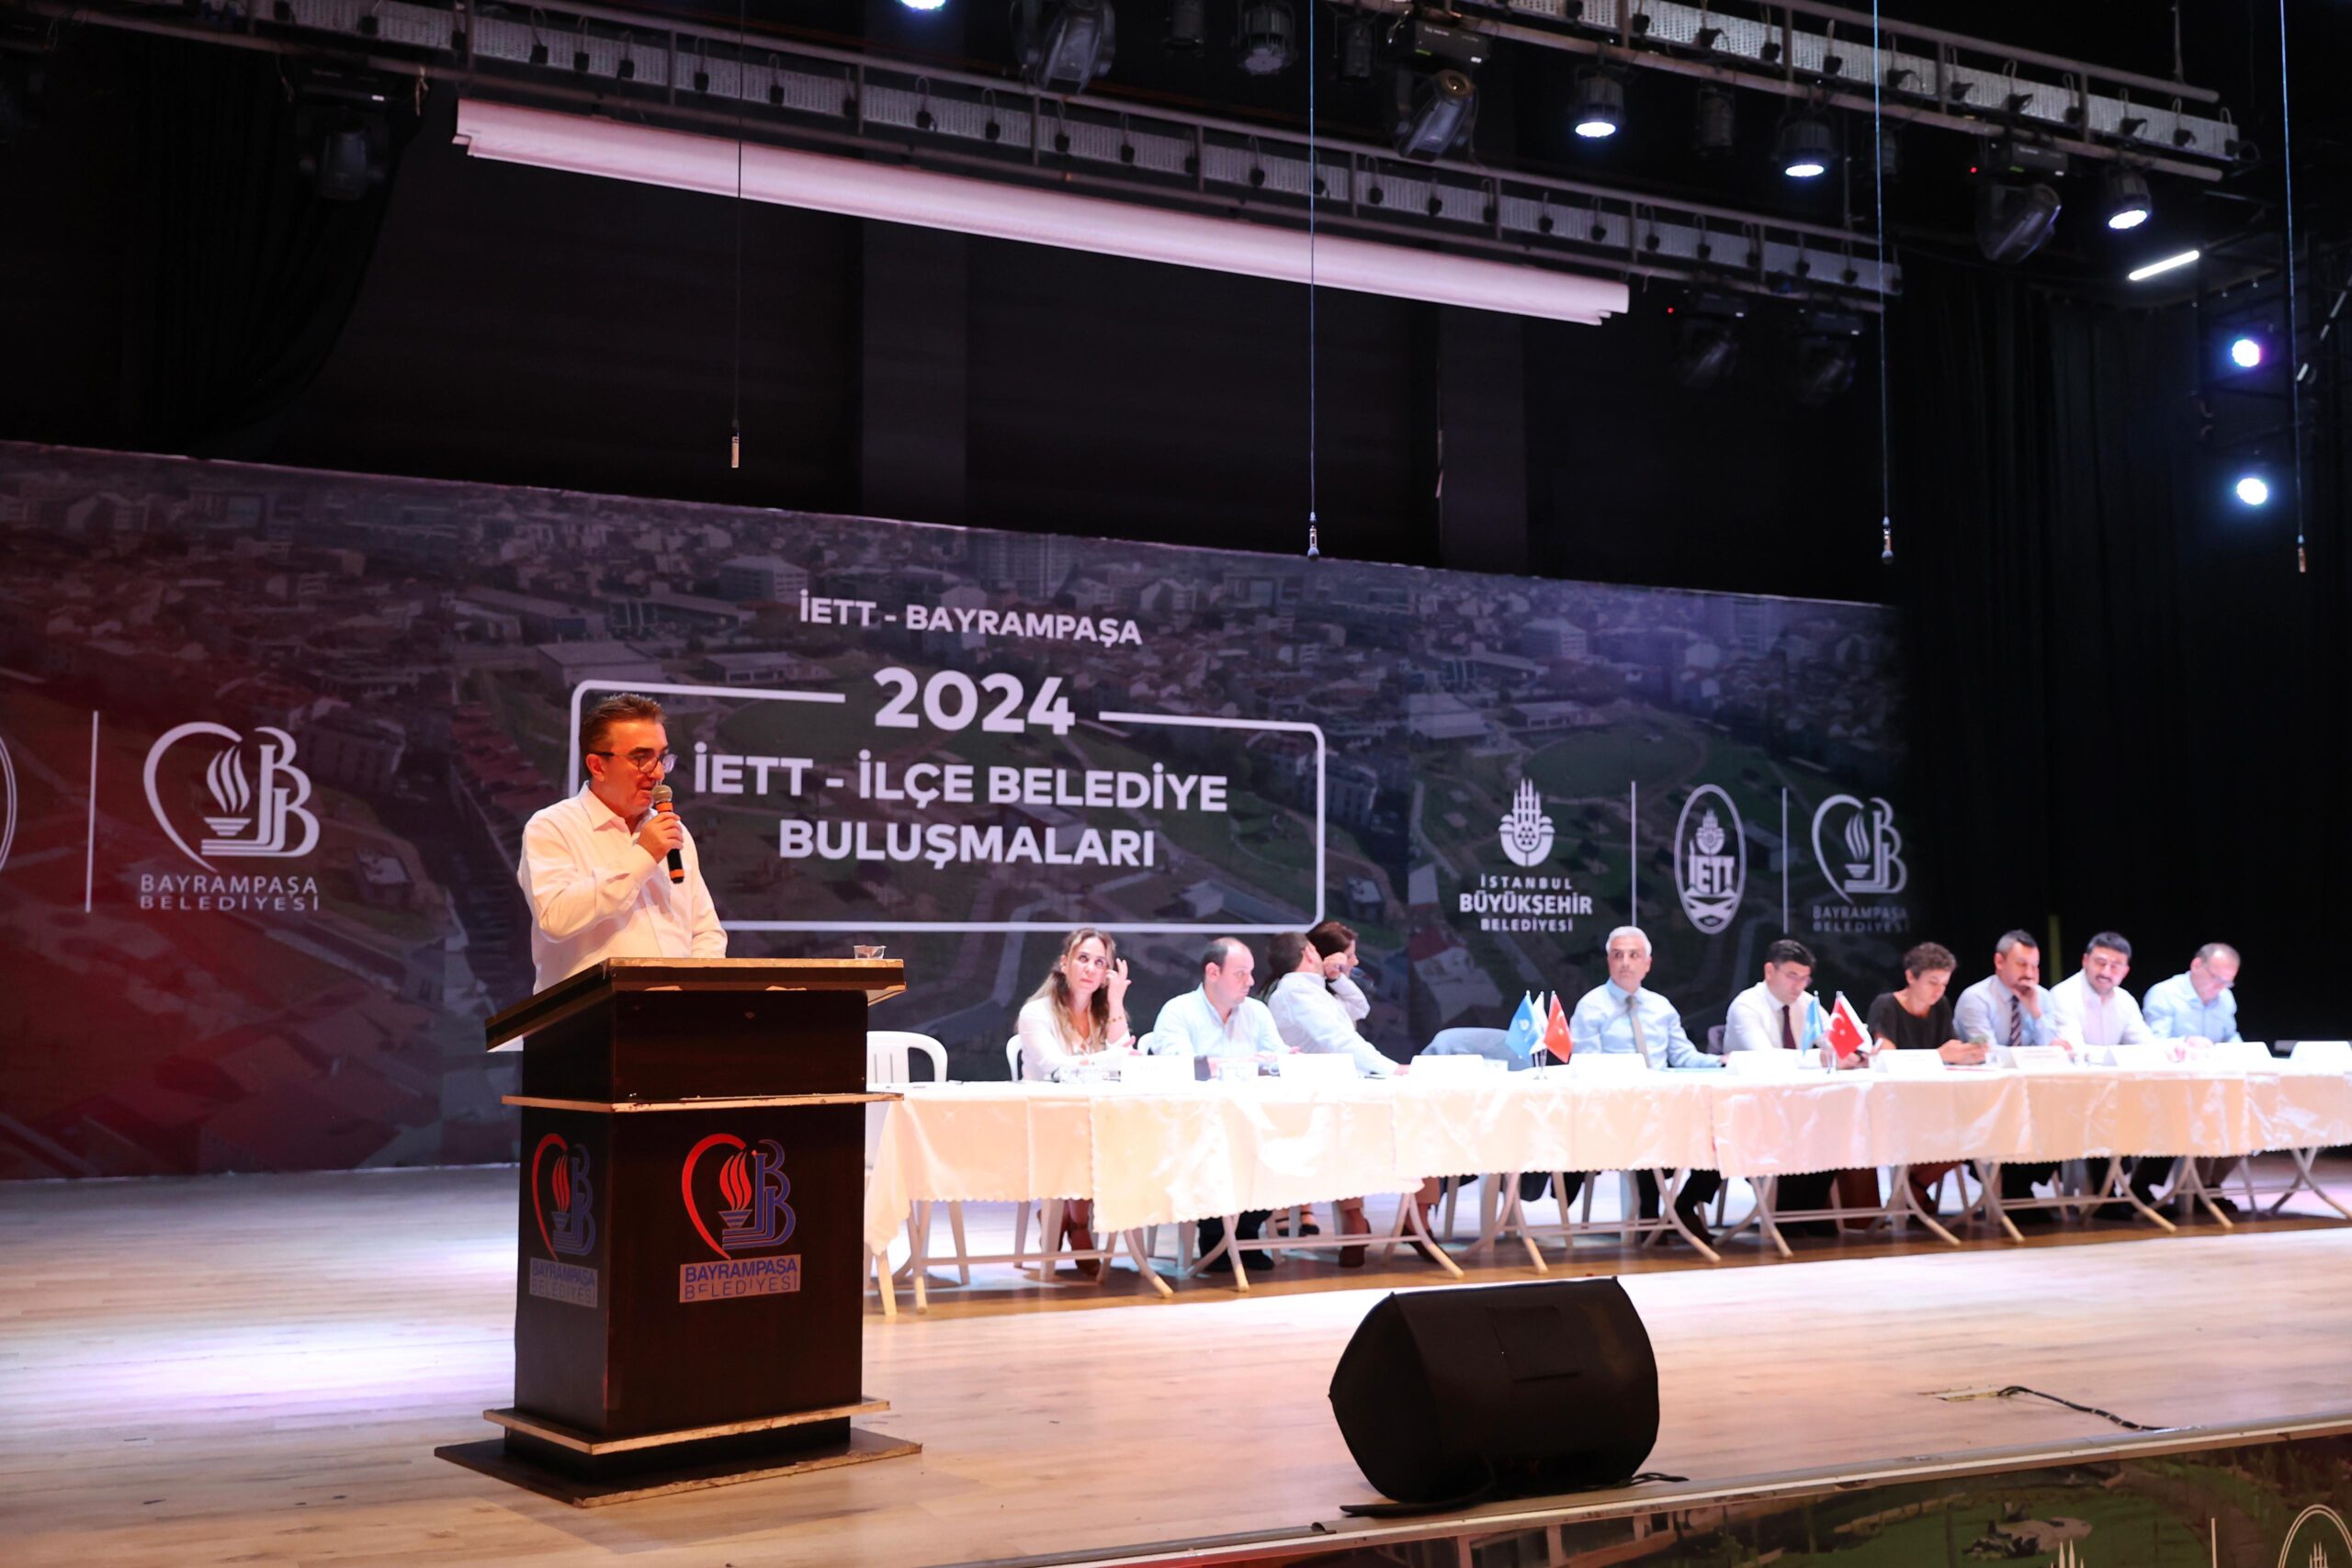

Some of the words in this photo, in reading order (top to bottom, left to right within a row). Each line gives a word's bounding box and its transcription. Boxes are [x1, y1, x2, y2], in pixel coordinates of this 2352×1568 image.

[799, 589, 876, 626] İETT
[906, 604, 1143, 648] BAYRAMPAŞA
[874, 667, 1076, 735] 2024
[695, 741, 813, 795] İETT
[859, 750, 974, 809] İLÇE
[989, 761, 1228, 812] BELEDİYE
[780, 819, 1155, 870] BULUŞMALARI
[140, 874, 319, 897] BAYRAMPAŞA
[1480, 874, 1573, 890] İSTANBUL
[140, 896, 319, 911] BELEDİYESİ
[1459, 889, 1593, 916] BÜYÜKŞEHİR
[1480, 917, 1574, 932] BELEDİYESİ
